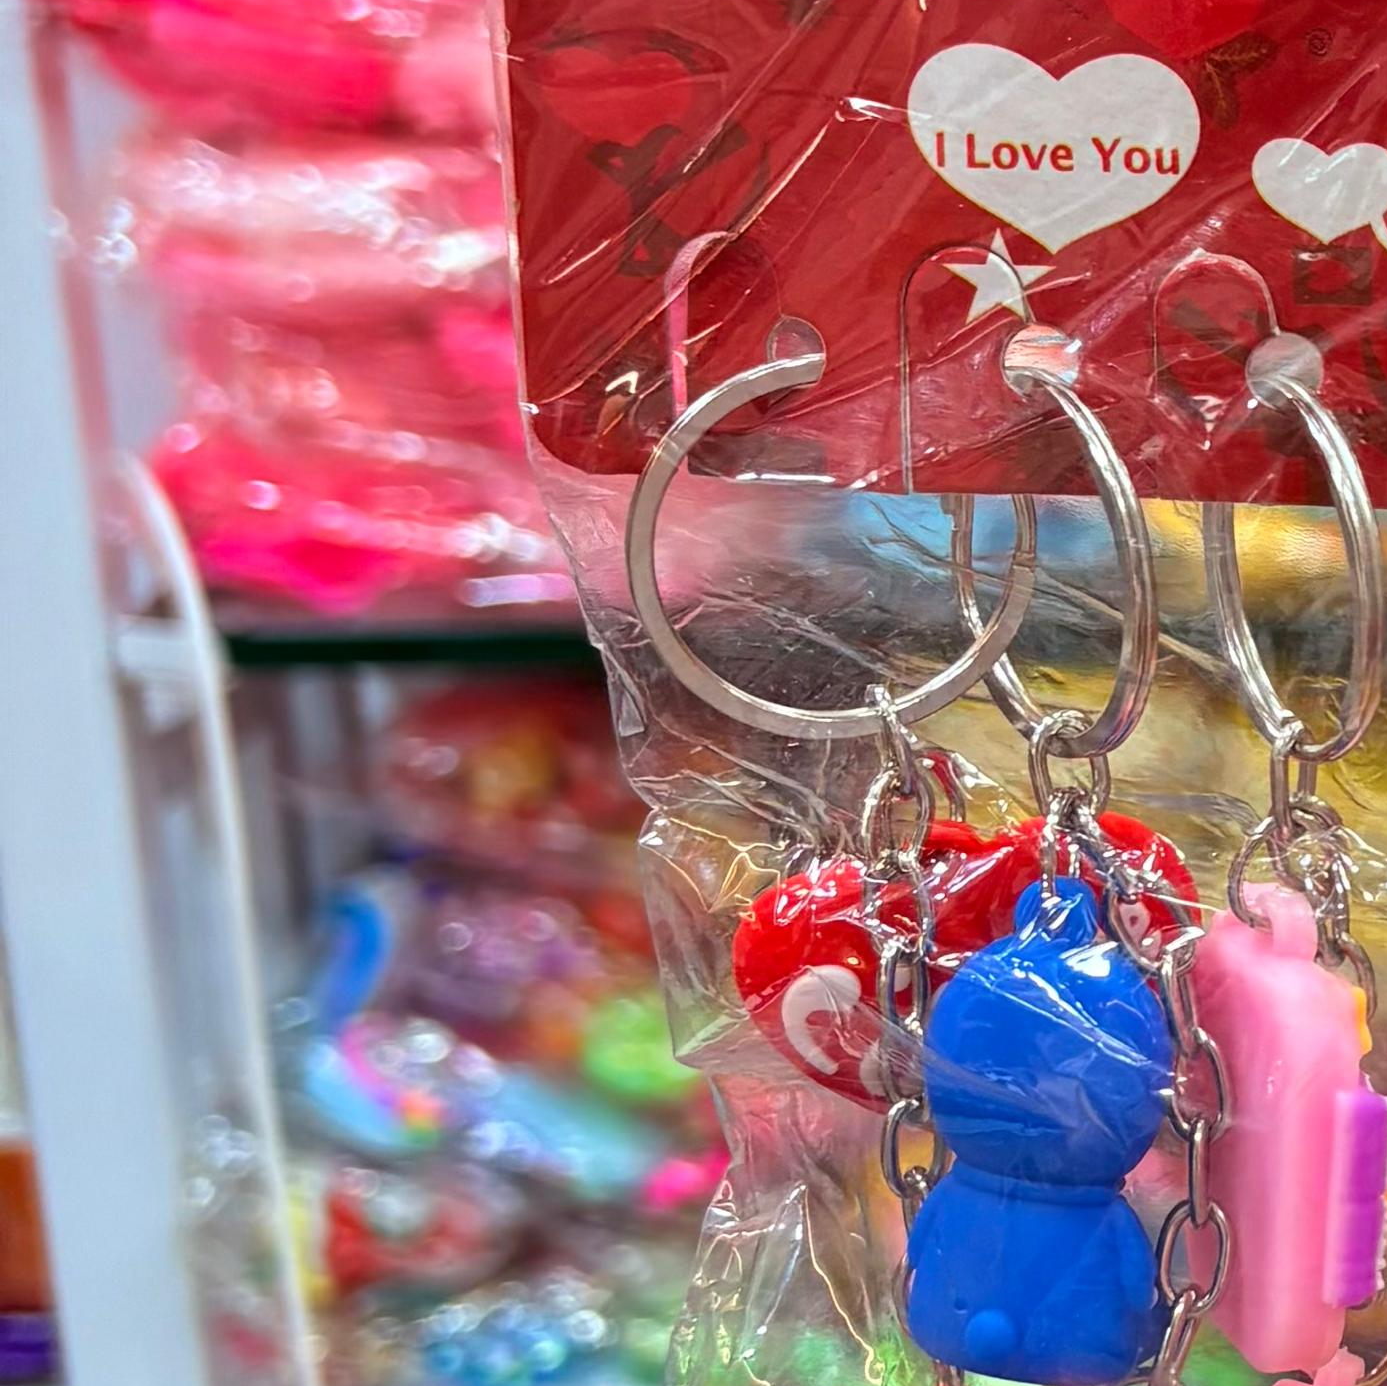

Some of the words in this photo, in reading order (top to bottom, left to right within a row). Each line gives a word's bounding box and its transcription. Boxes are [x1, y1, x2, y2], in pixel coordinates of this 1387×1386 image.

[935, 131, 946, 169] I
[966, 132, 1075, 173] Love
[1091, 136, 1181, 176] You
